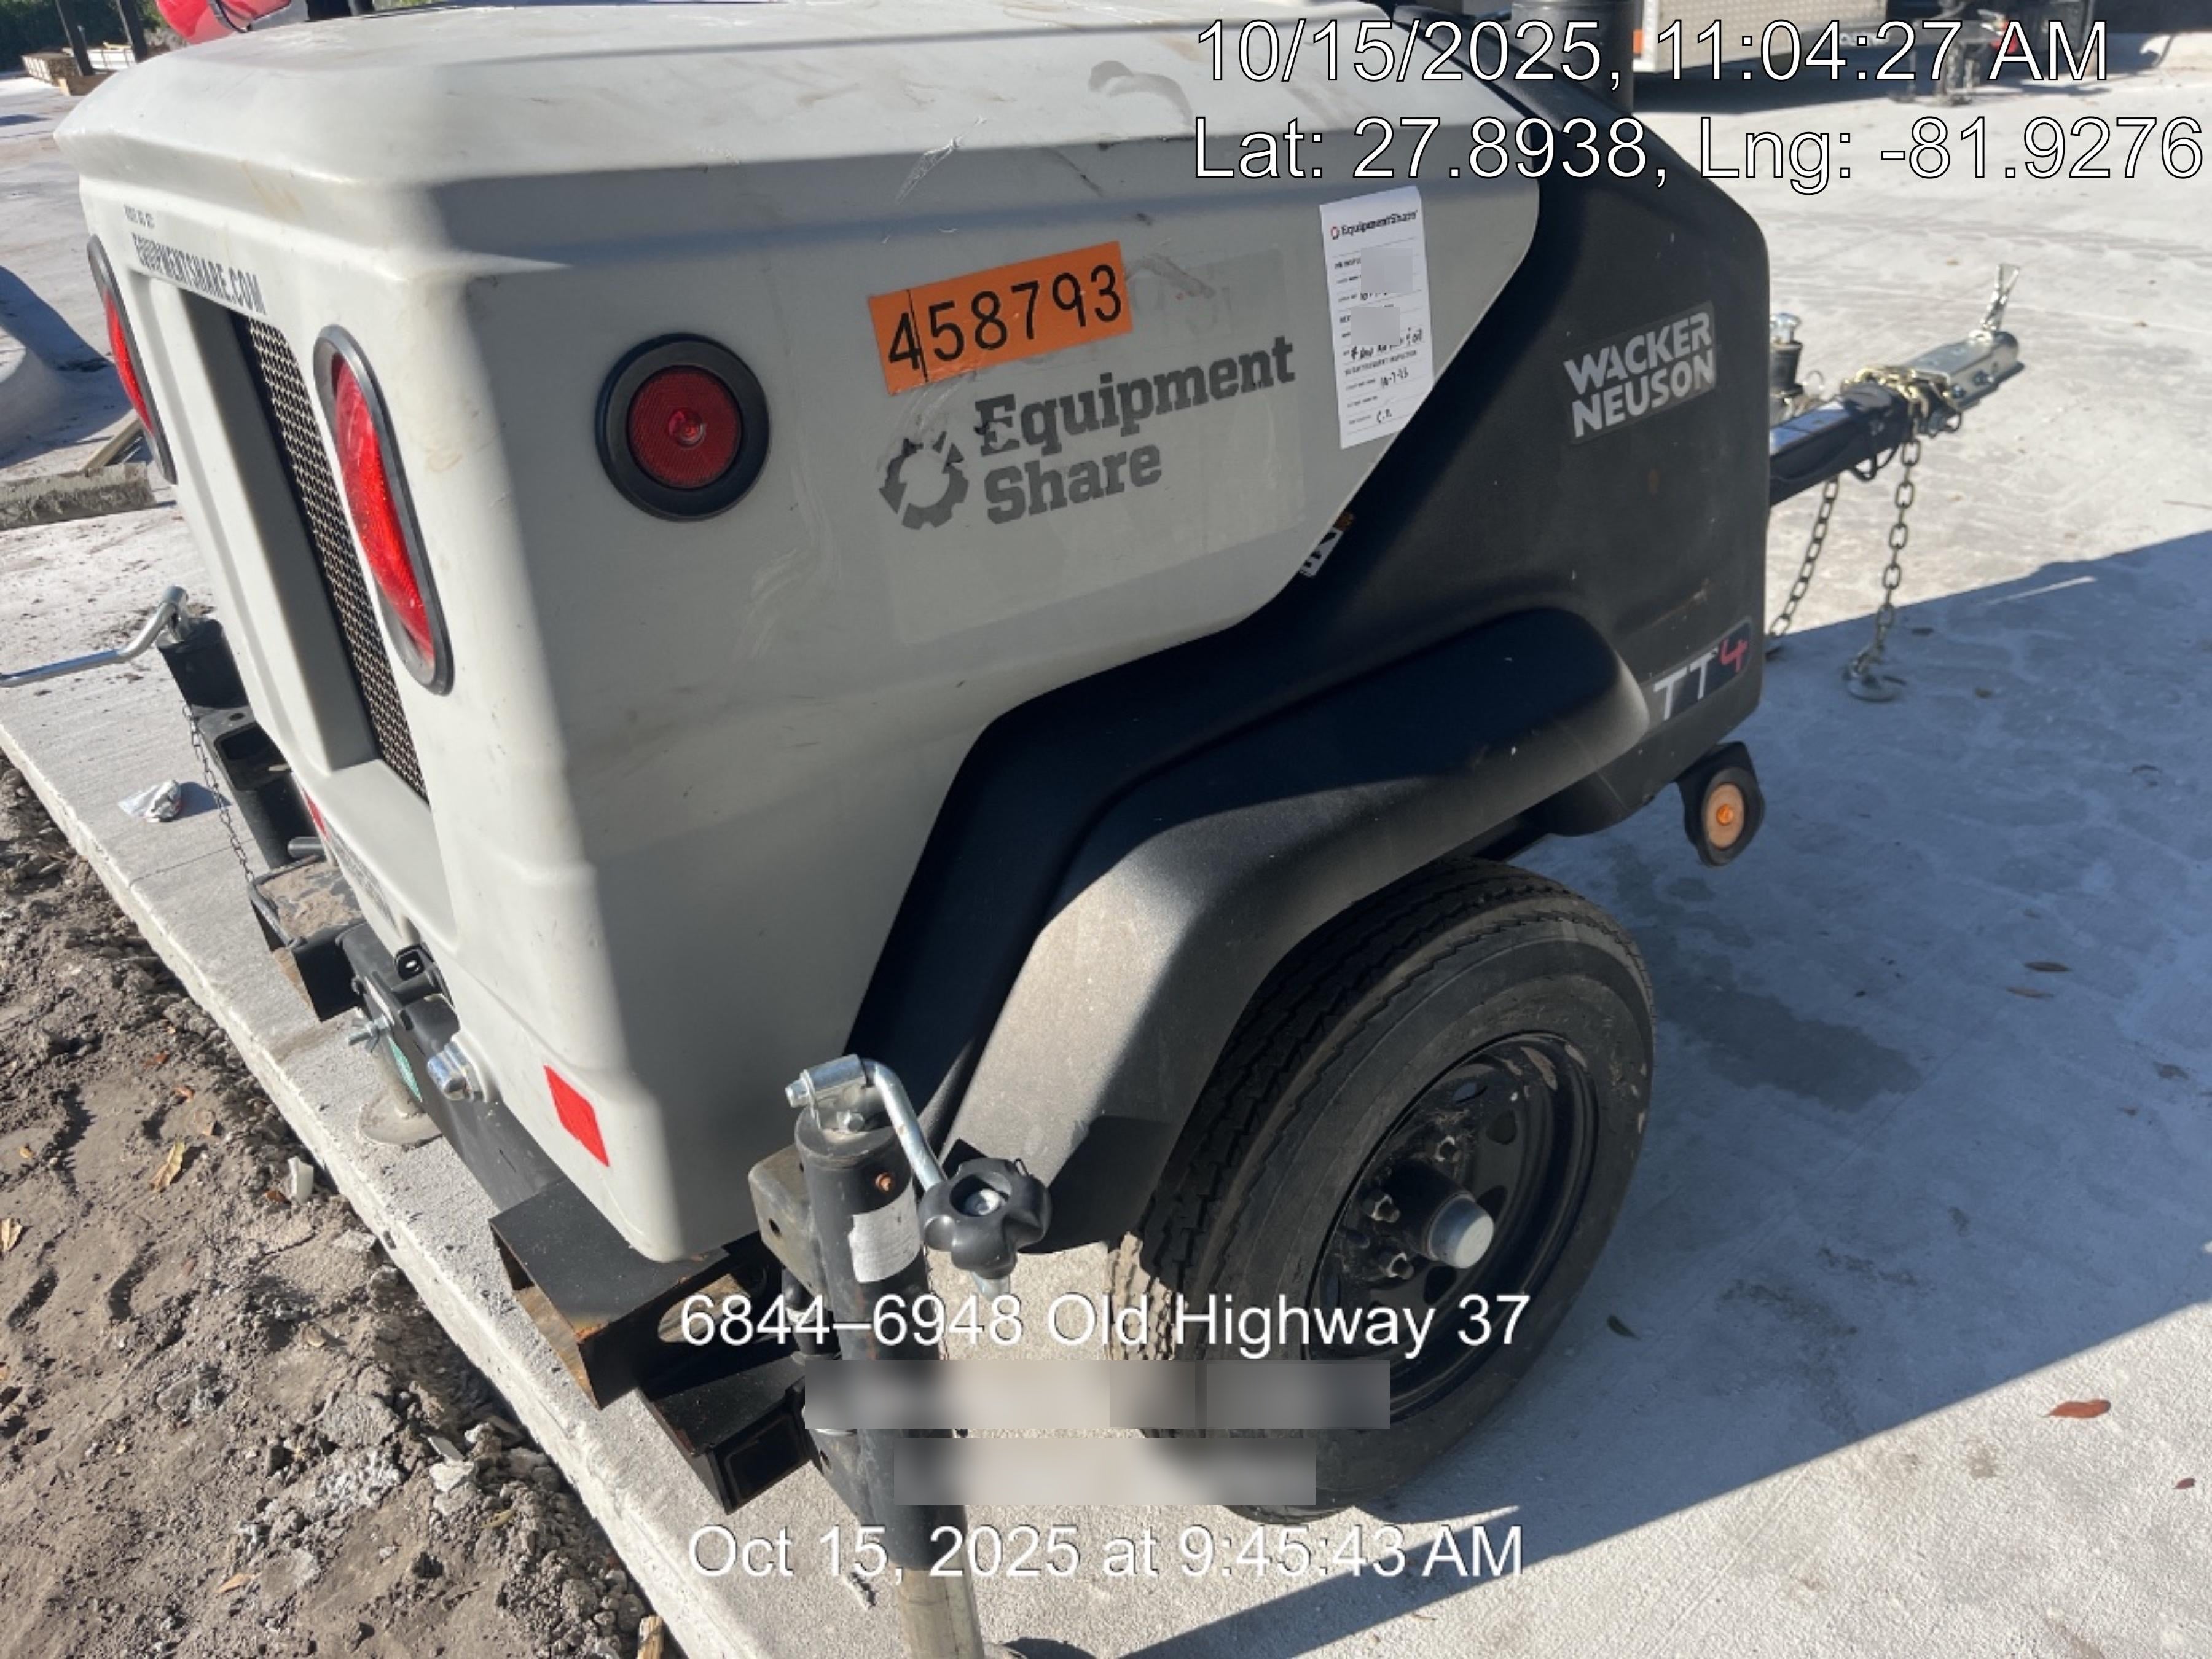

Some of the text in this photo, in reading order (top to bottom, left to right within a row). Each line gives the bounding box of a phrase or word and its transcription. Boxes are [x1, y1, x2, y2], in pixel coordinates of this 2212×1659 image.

[888, 264, 1122, 370] 458793
[1563, 312, 1712, 395] WACKER
[975, 335, 1295, 455] Equipment
[1572, 348, 1713, 438] NEUSON
[983, 444, 1163, 524] Share
[1653, 638, 1748, 721] TT4
